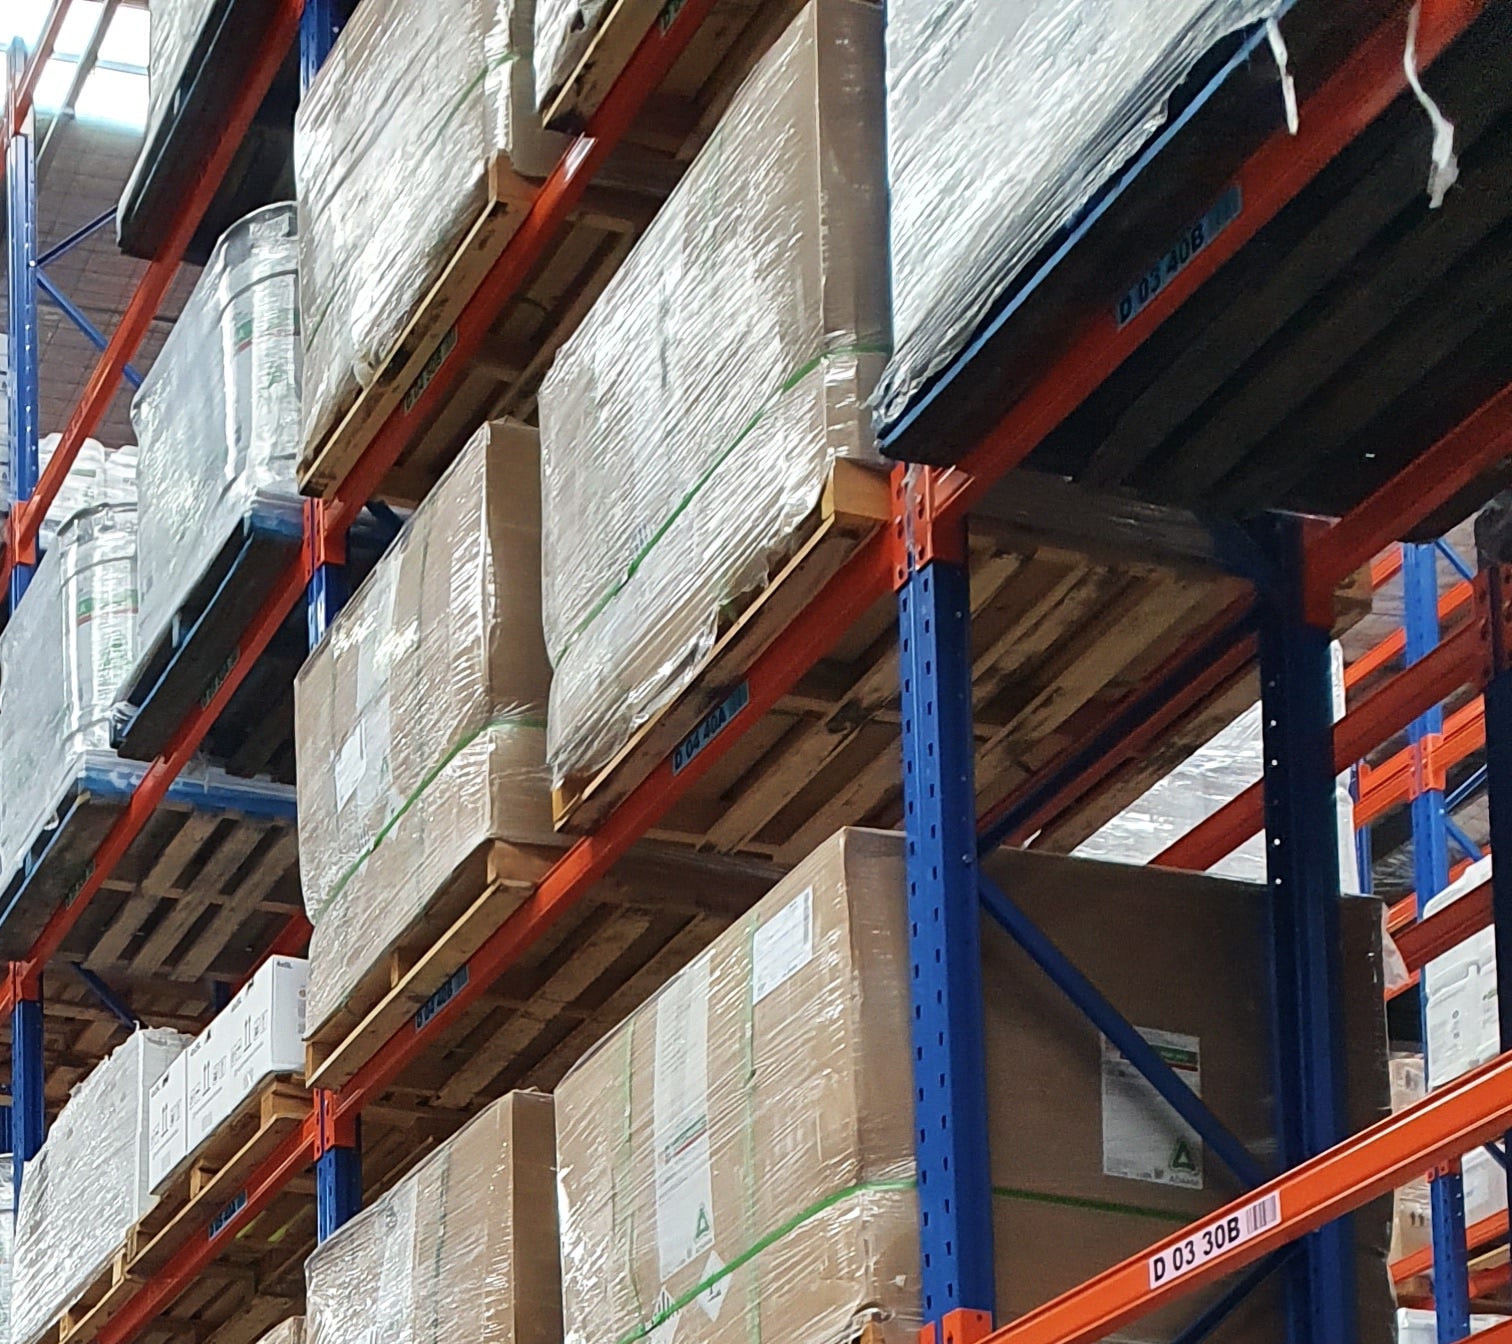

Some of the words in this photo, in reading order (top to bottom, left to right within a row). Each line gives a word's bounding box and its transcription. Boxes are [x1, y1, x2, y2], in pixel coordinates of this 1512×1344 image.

[1119, 294, 1132, 324] D
[675, 748, 683, 770] D
[1153, 1256, 1166, 1282] D
[1172, 1240, 1196, 1271] 03
[1202, 1216, 1241, 1256] 30B
